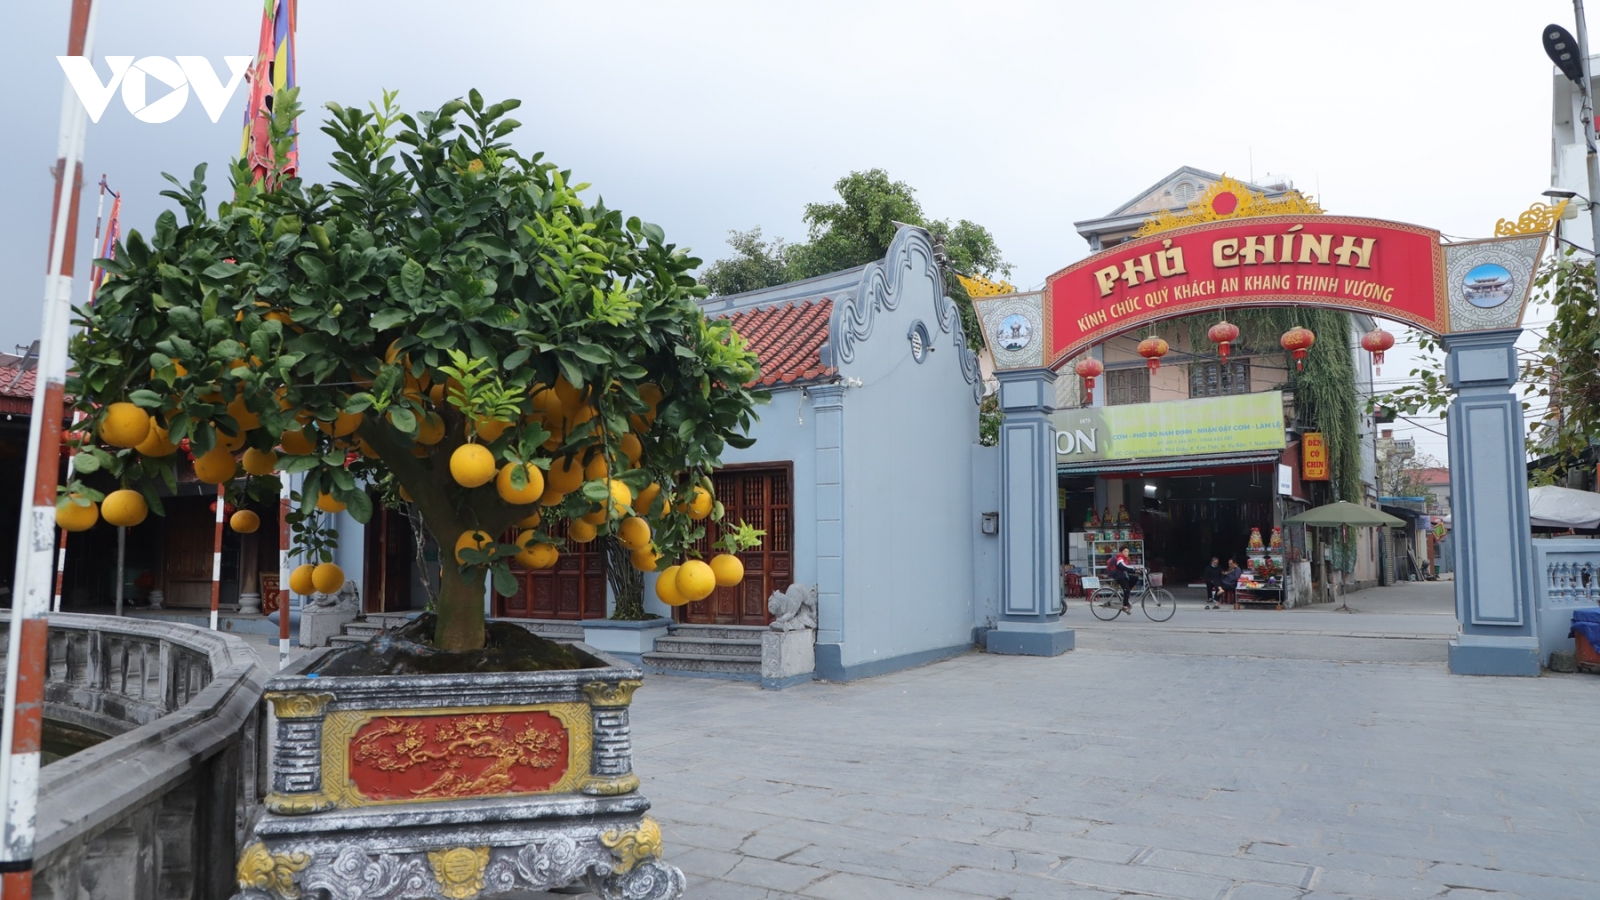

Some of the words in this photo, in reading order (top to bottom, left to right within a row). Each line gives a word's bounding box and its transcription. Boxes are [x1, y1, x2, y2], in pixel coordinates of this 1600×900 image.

[1093, 238, 1188, 298] PHỦ
[1211, 223, 1378, 270] CHÍNH
[1077, 310, 1108, 333] KÍNH
[1110, 294, 1142, 319] CHÚC
[1145, 285, 1169, 308] QUÝ
[1173, 279, 1216, 301] KHÁCH
[1220, 277, 1239, 293] AN
[1244, 274, 1291, 291] KHANG
[1296, 275, 1339, 295] THỊNH
[1344, 279, 1395, 303] VƯỢNG
[1175, 428, 1192, 437] ĐỊNH
[1233, 423, 1250, 431] CƠM
[1255, 421, 1271, 430] LÀM
